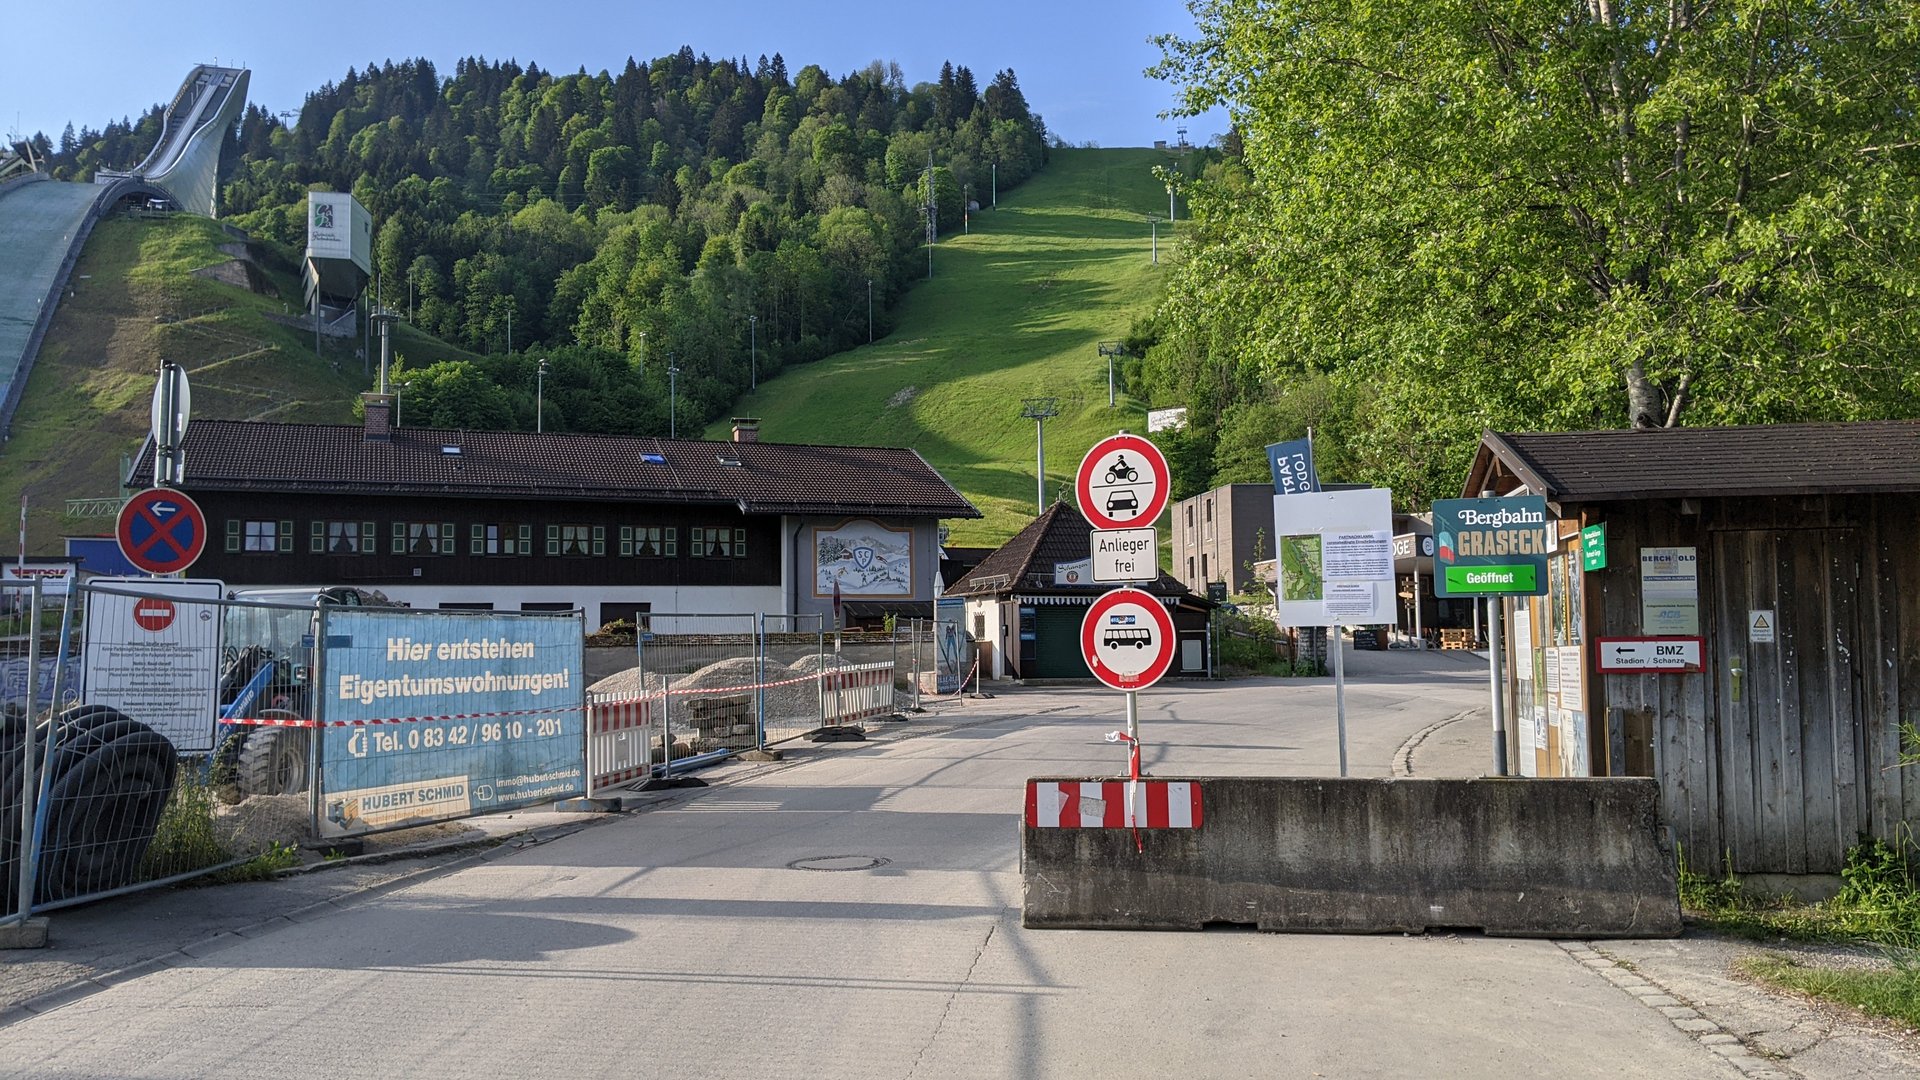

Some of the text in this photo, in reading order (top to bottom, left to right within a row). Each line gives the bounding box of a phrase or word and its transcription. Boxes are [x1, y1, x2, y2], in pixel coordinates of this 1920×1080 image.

[1458, 507, 1543, 527] Bergbahn
[1099, 538, 1149, 554] Anlieger
[1458, 529, 1545, 557] GRASECK
[1115, 559, 1135, 573] frei
[1466, 572, 1514, 584] Geöffnet
[387, 637, 534, 661] Hier entstehen
[1656, 646, 1684, 655] BMZ
[340, 668, 569, 704] Eigentumswohnungen!
[373, 731, 404, 753] Tel.
[408, 729, 419, 750] 0
[423, 727, 444, 748] 83
[448, 725, 467, 745] 42
[471, 723, 479, 744] /
[481, 722, 501, 742] 96
[505, 721, 522, 739] 10
[537, 718, 562, 737] 201
[362, 784, 464, 811] HUBERT SCHMID
[498, 783, 574, 802] www.hubert-schmid.de
